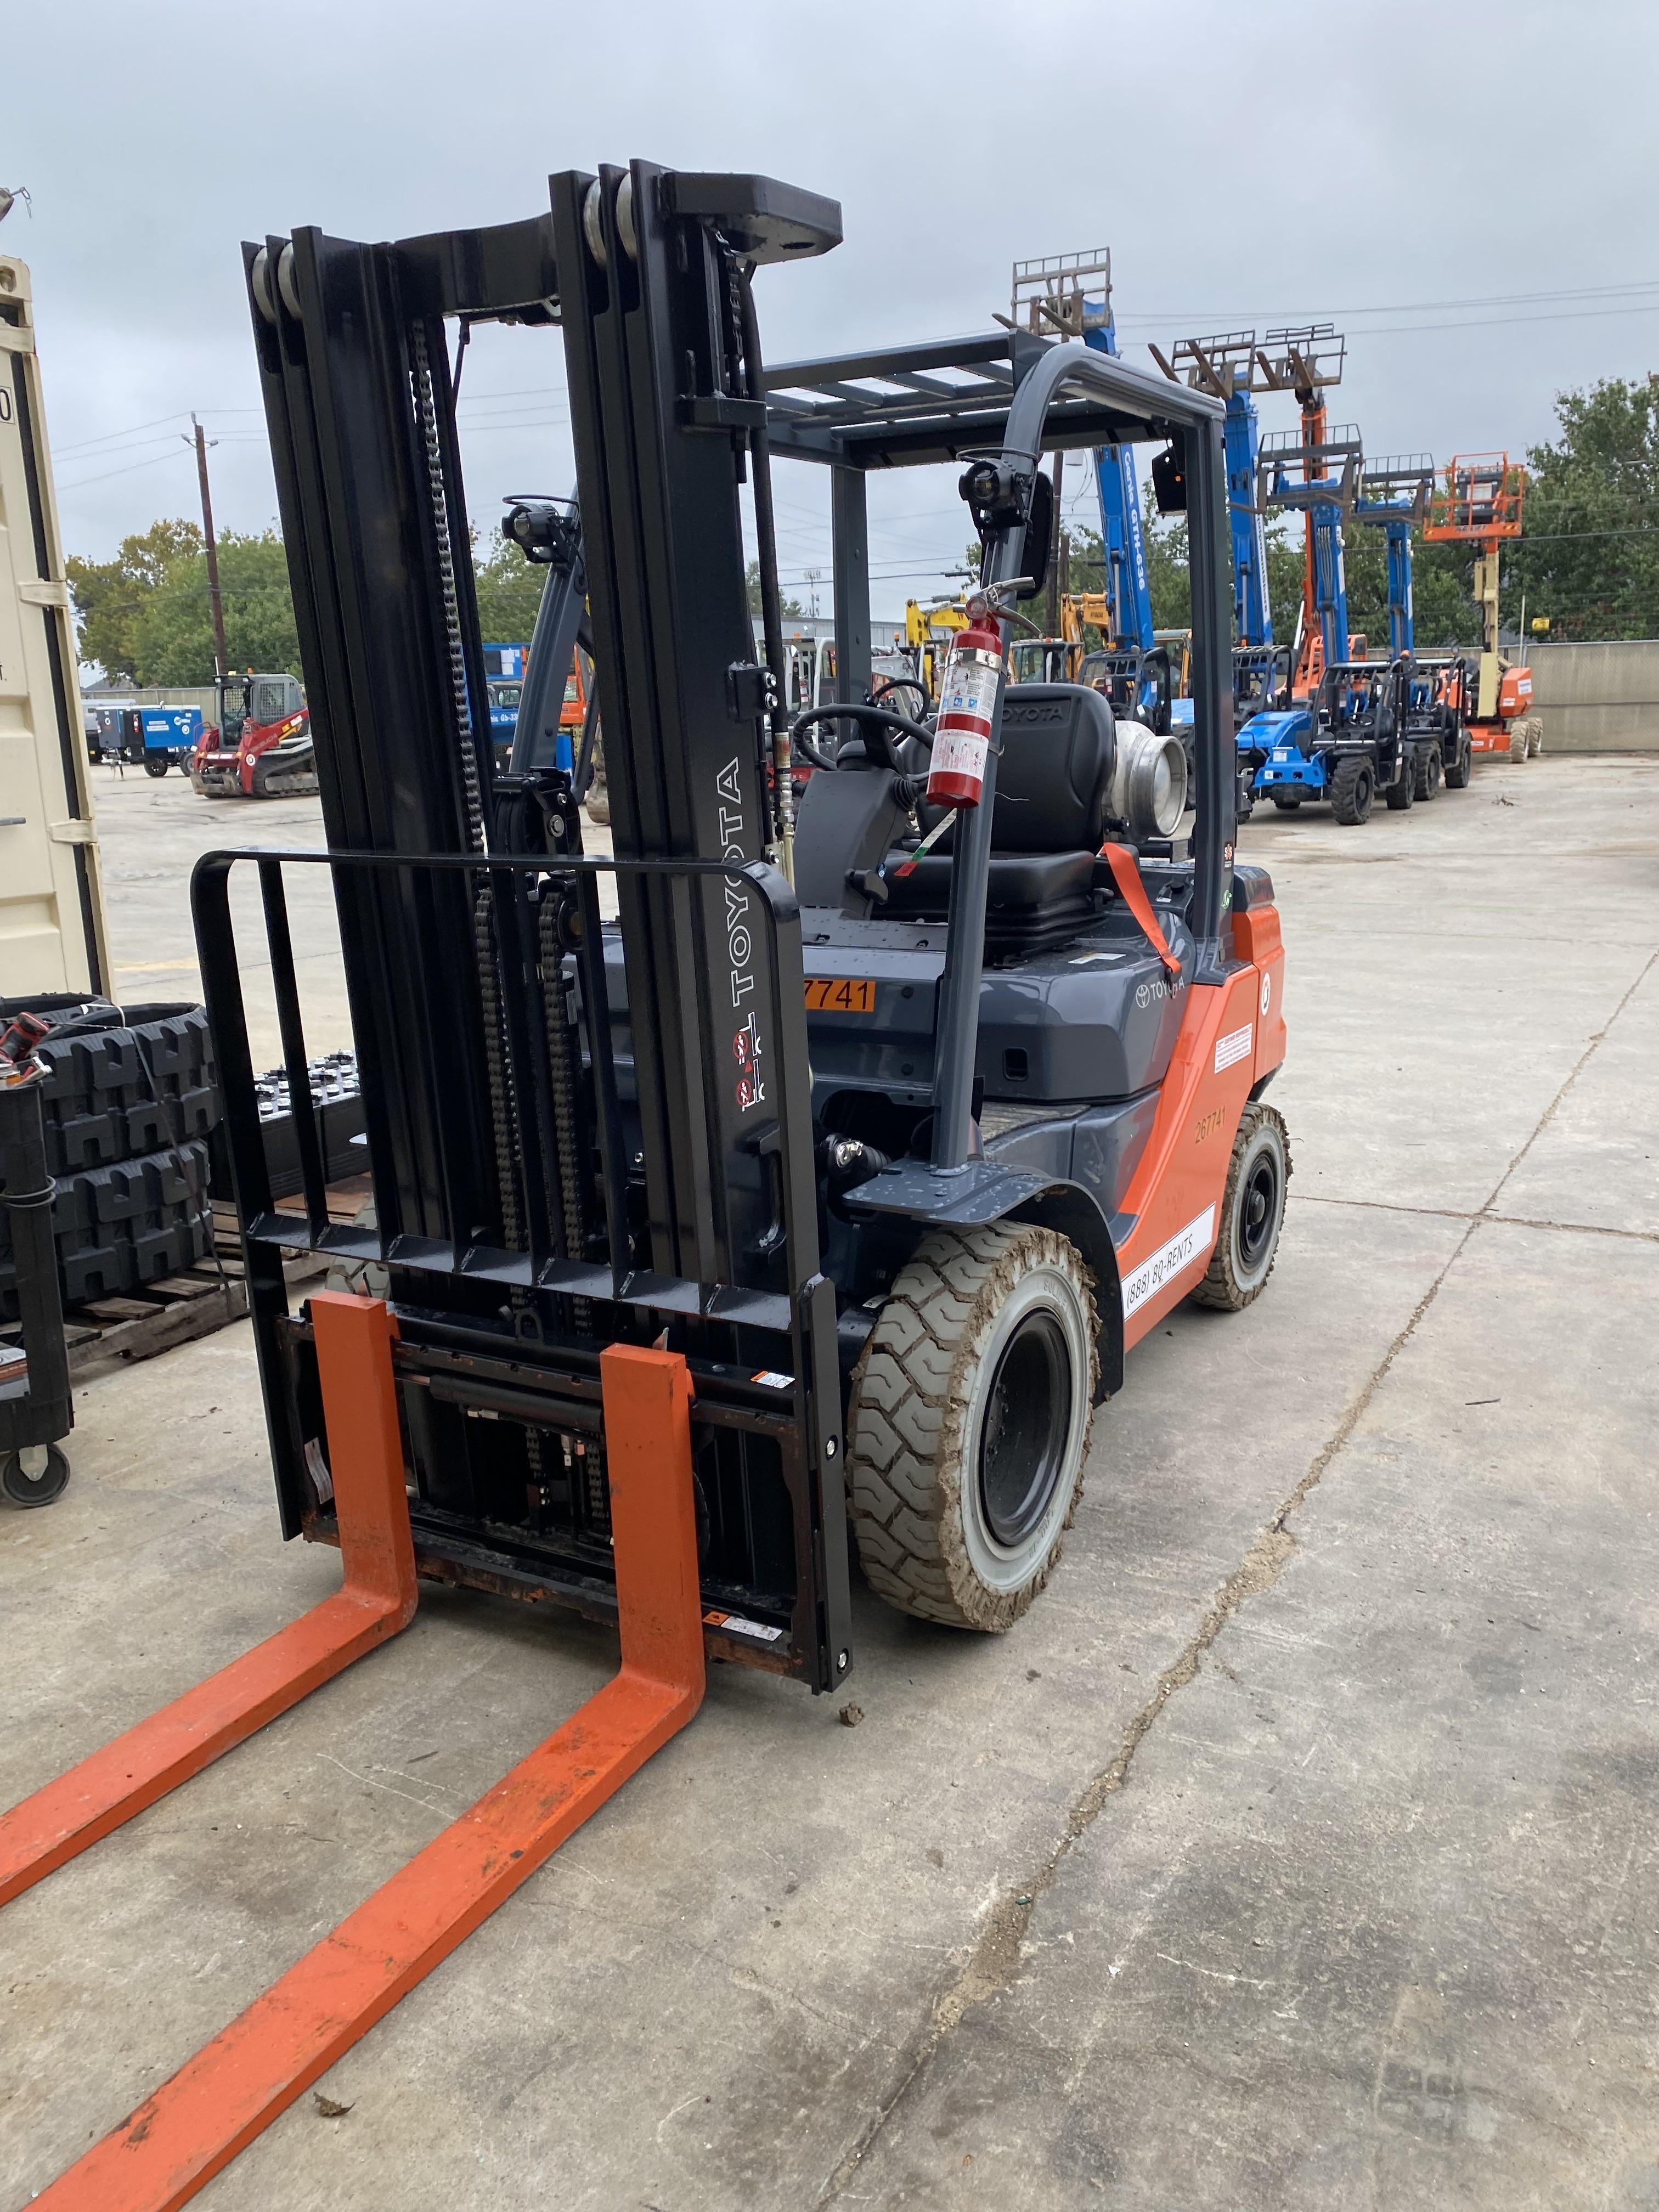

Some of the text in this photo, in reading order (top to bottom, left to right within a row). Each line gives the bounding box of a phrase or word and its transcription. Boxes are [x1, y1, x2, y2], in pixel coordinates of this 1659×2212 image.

[1124, 451, 1146, 591] Genie GTH-636
[1257, 514, 1269, 613] quipmentShare
[1001, 706, 1063, 723] OYOTA
[1150, 975, 1185, 1001] TOYA
[1195, 1105, 1226, 1144] 267741
[1126, 1233, 1193, 1310] (888) 80-RENTS
